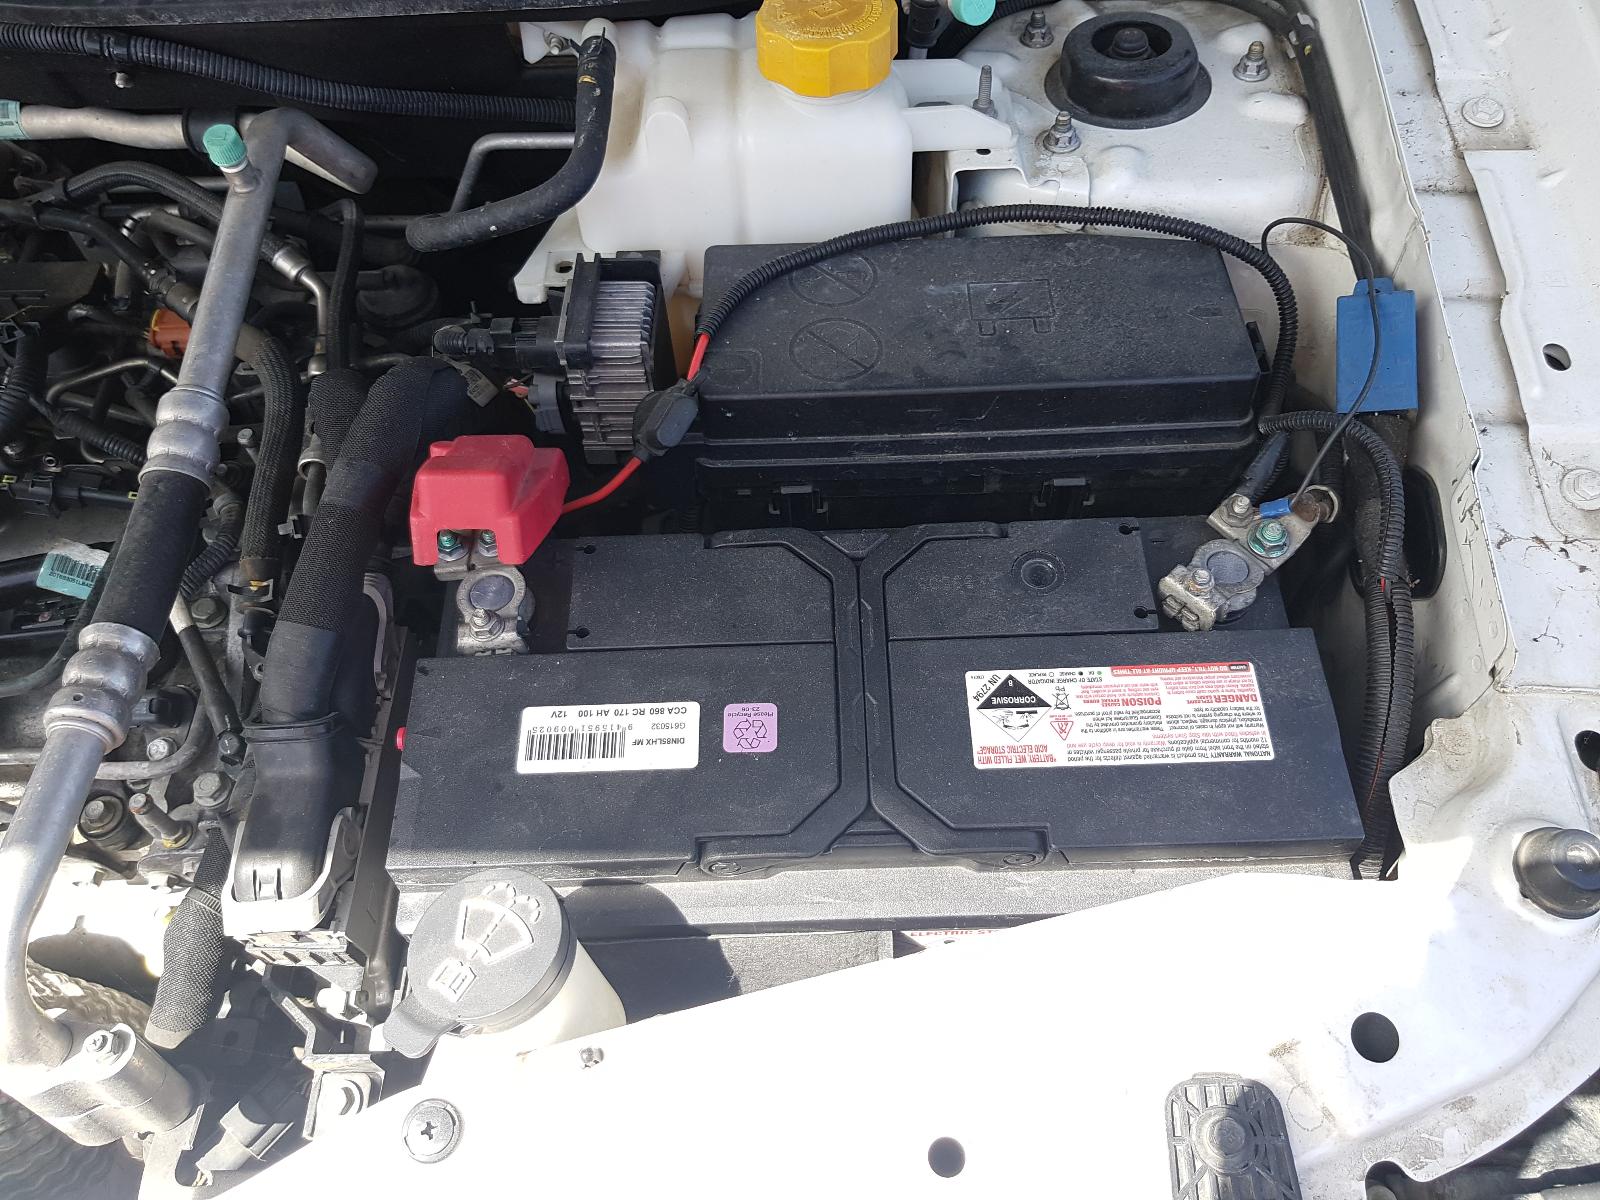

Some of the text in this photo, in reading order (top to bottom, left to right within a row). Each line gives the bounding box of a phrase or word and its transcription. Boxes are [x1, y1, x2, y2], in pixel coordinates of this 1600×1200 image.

[972, 674, 1001, 701] UN 2794
[991, 696, 1036, 704] CORROSIVE
[1122, 697, 1161, 706] POISON
[1213, 694, 1258, 703] DANGER
[596, 709, 609, 717] AH
[650, 707, 665, 715] 860
[667, 706, 686, 714] CCA
[1006, 745, 1033, 753] ELECTRIC
[1034, 744, 1048, 753] ACID
[977, 756, 992, 764] WITH
[994, 755, 1012, 764] FILLED
